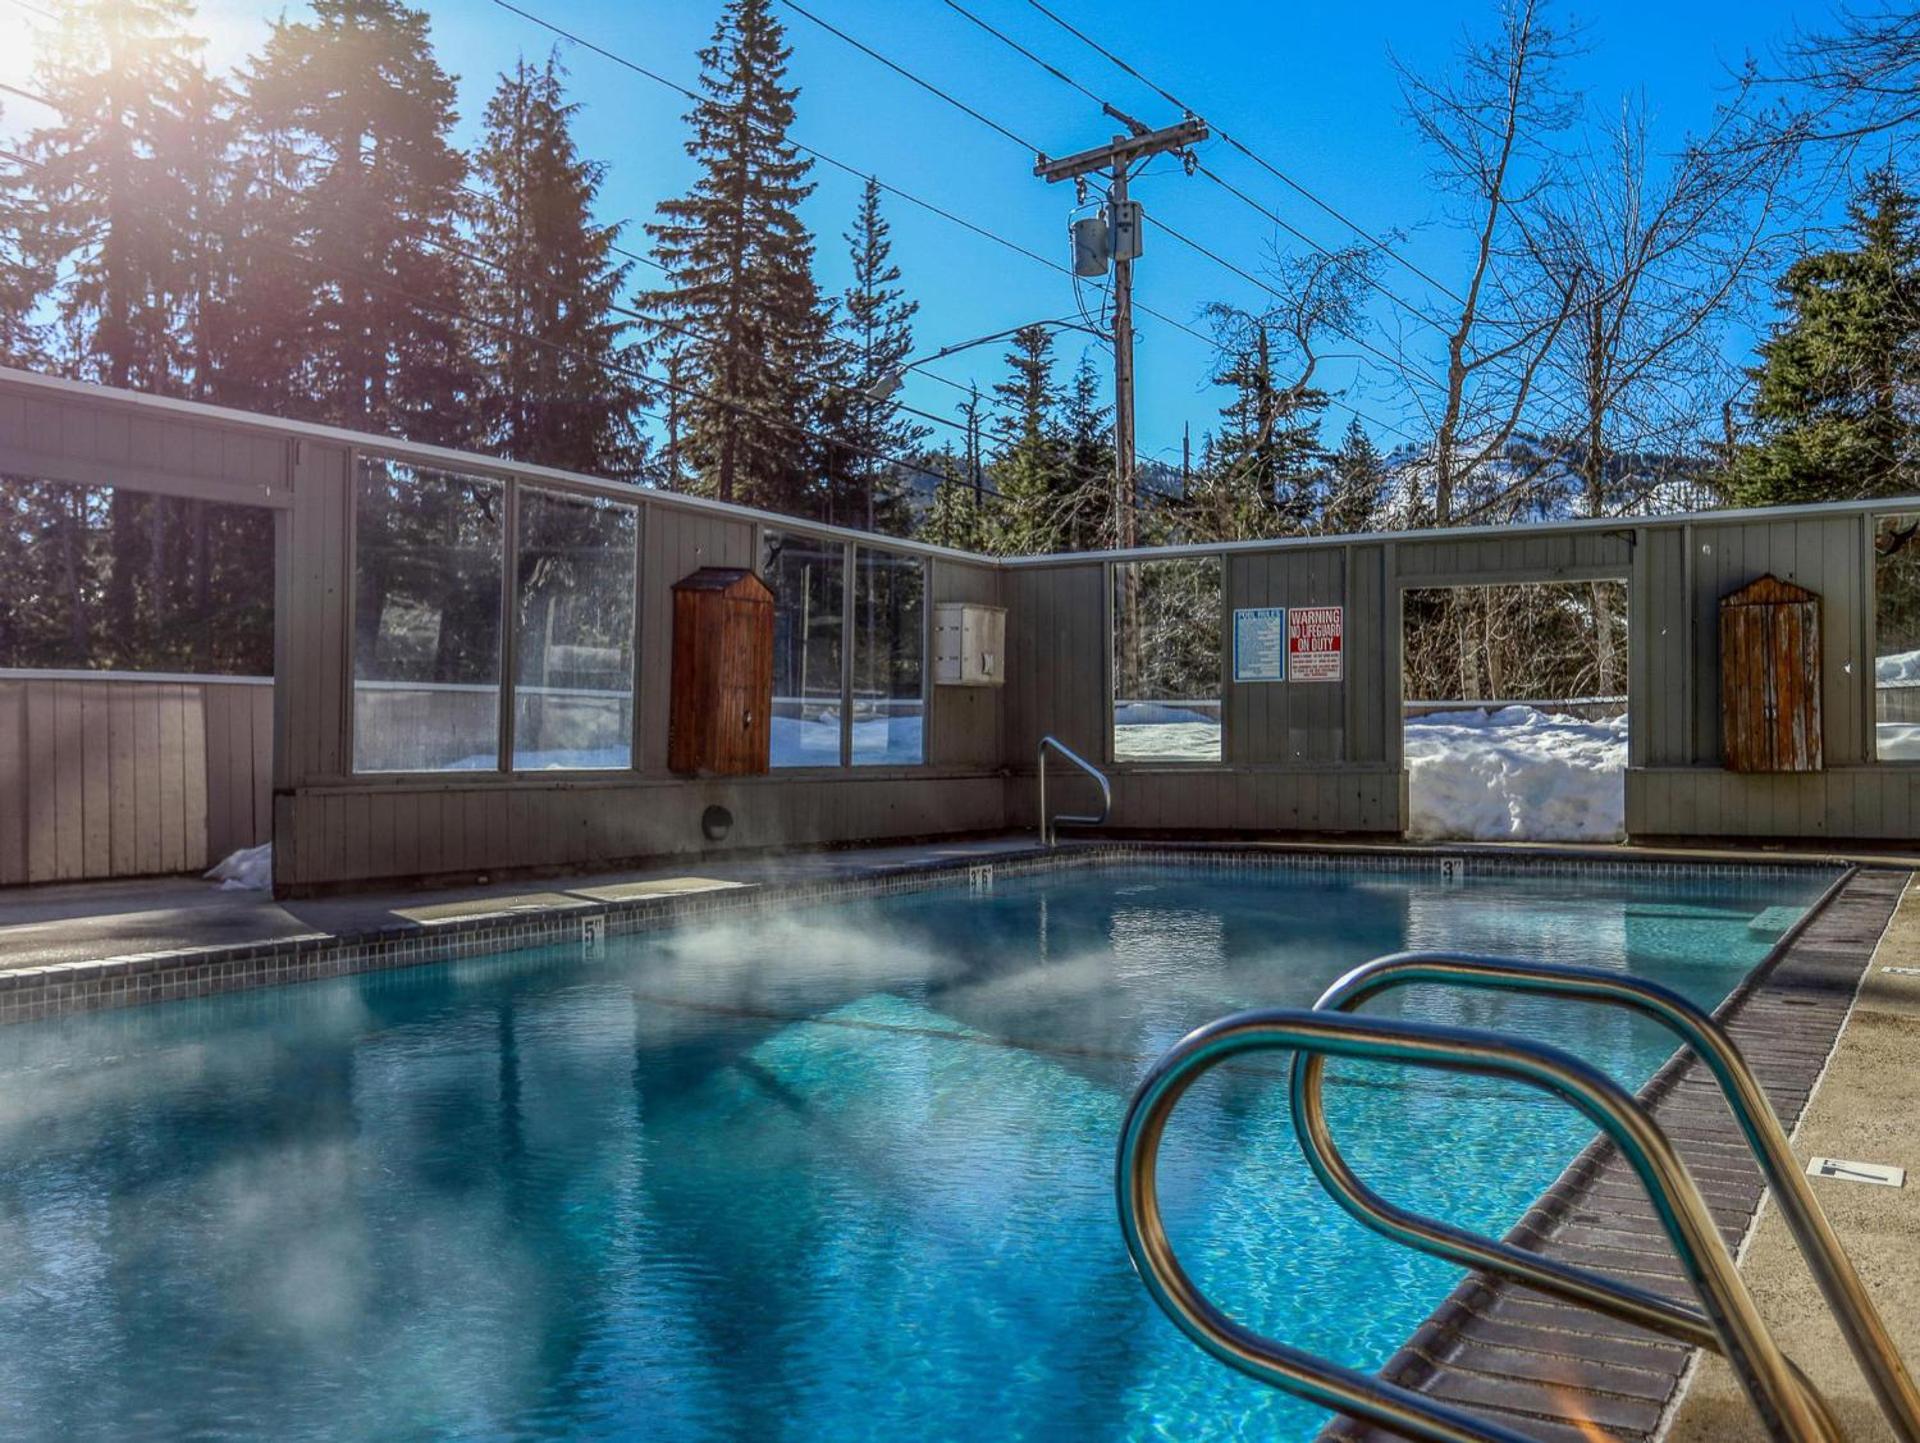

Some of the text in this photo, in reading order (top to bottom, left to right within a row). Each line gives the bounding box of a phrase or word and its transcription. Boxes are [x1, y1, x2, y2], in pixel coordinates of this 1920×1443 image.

[1291, 609, 1340, 625] WARNING
[1290, 624, 1341, 638] NO LIFEGUARD
[1297, 638, 1334, 651] ON DUTY
